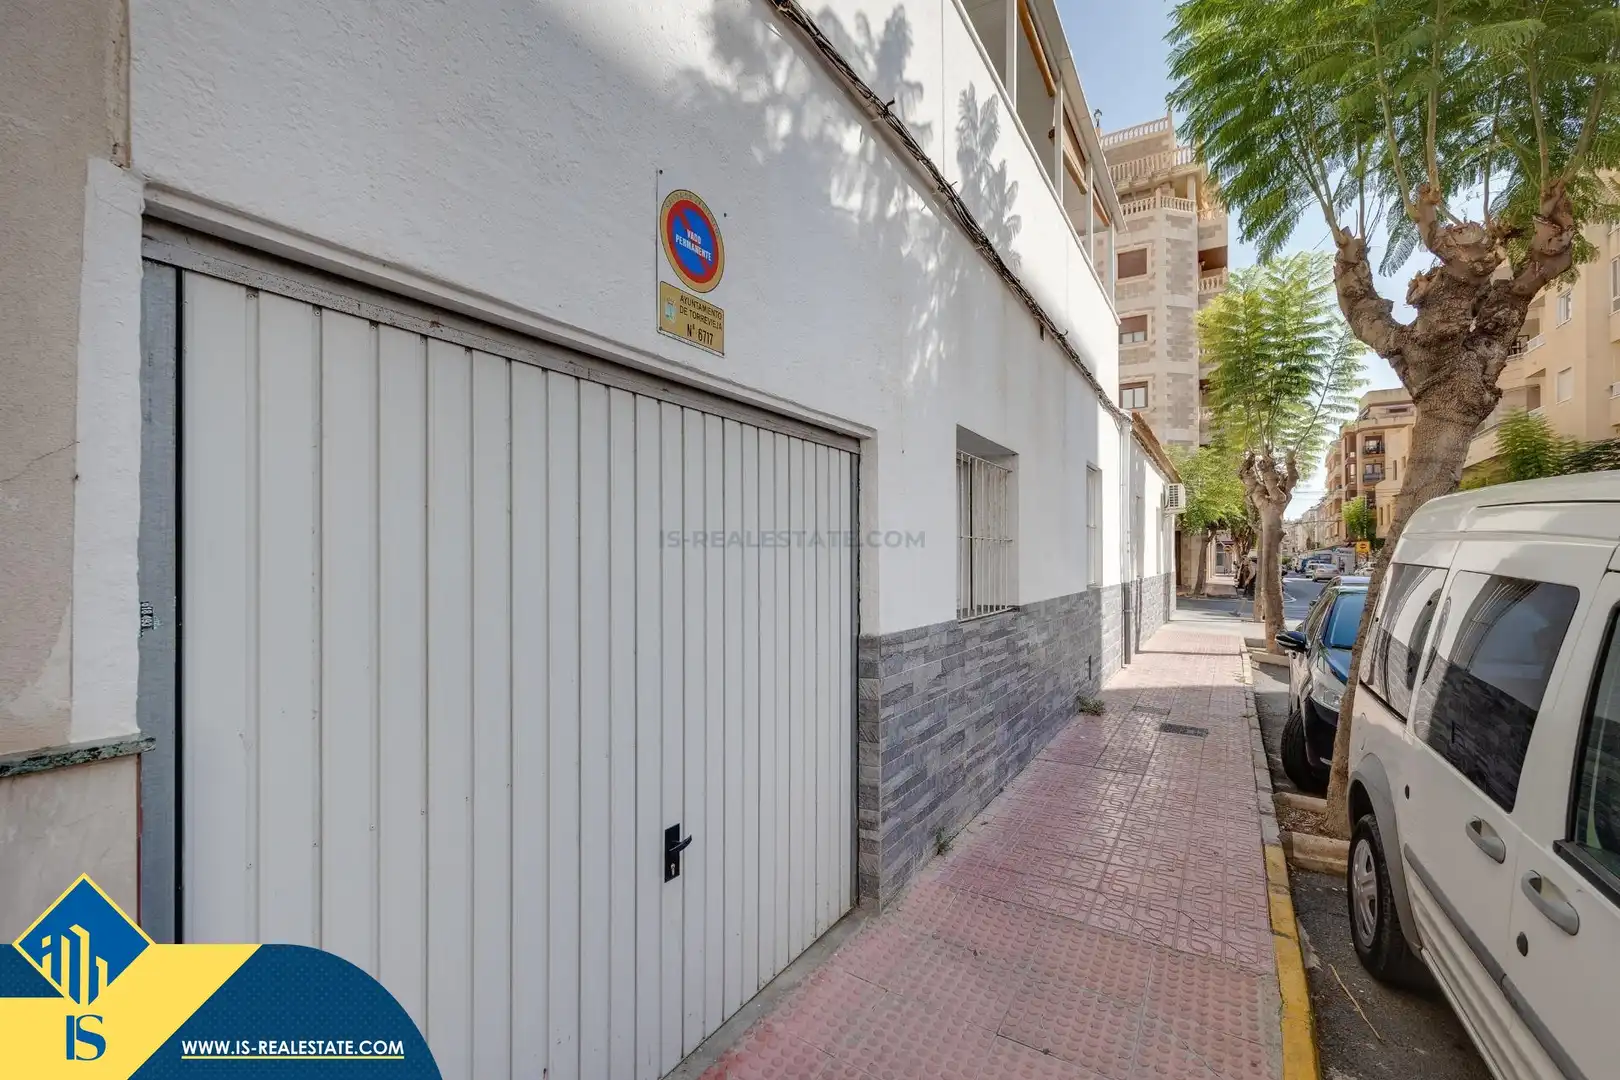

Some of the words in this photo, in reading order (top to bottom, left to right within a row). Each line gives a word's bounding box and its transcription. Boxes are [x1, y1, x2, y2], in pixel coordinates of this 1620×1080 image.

[675, 233, 712, 262] PERMANENTE
[686, 228, 702, 245] VADO
[679, 304, 688, 316] DE
[689, 309, 723, 331] TORREVIEJA
[680, 294, 723, 321] AYUNTAMIENTO
